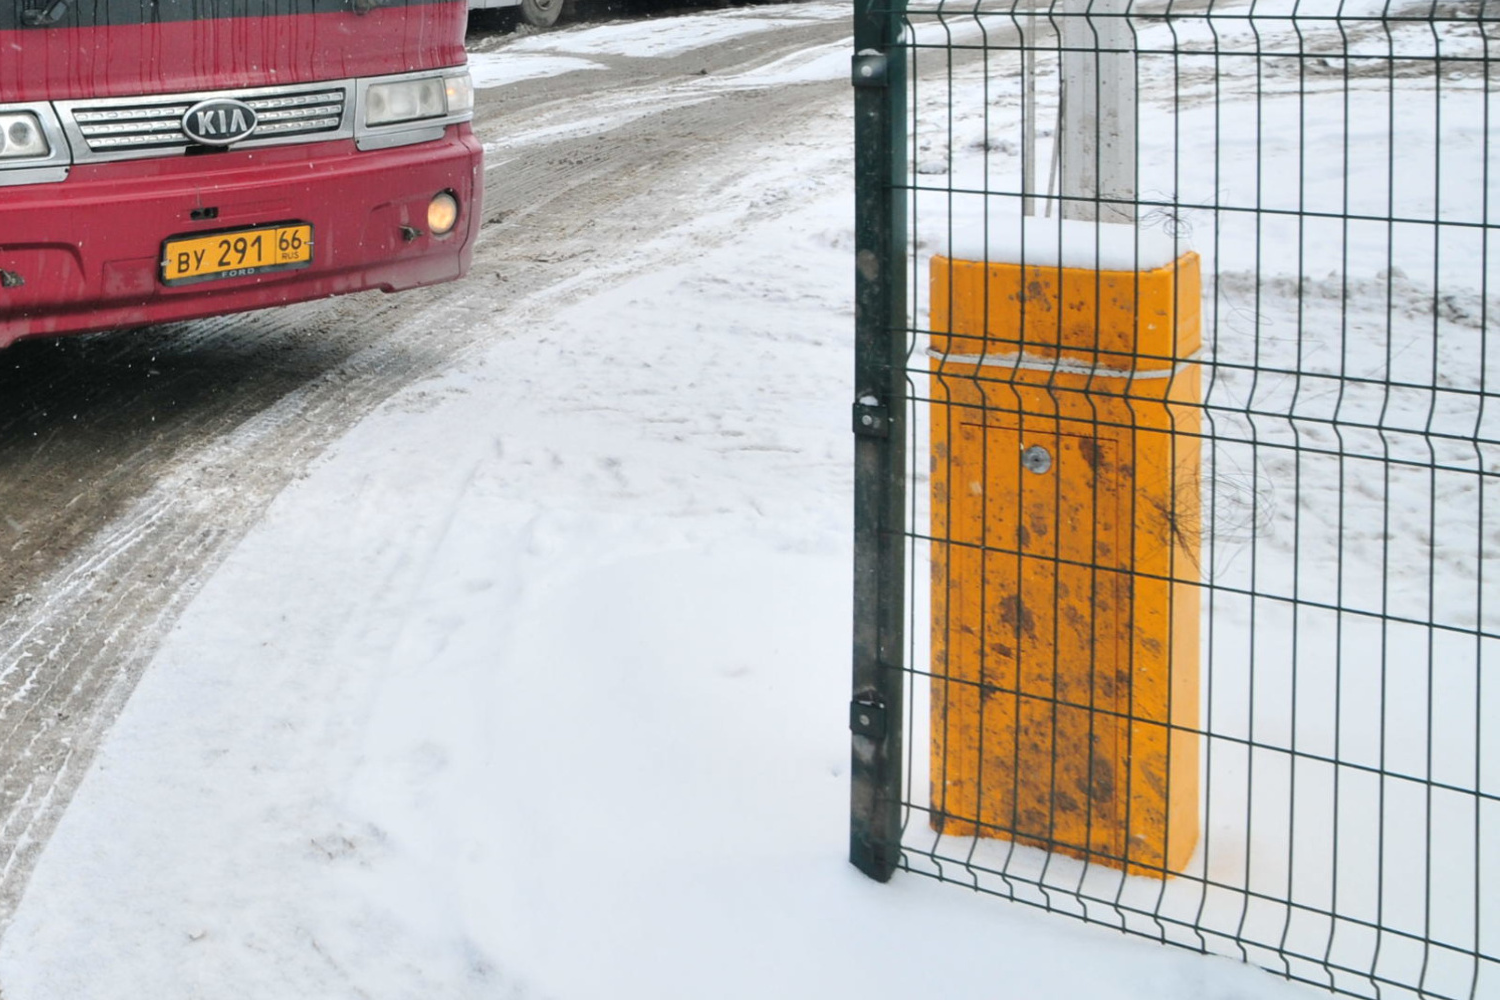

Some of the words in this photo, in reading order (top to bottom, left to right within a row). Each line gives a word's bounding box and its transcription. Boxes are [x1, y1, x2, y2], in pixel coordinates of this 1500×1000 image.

[197, 108, 248, 136] KIA
[217, 235, 262, 267] 291
[278, 229, 302, 252] 66
[281, 251, 299, 260] RUS
[221, 267, 255, 279] FORD
